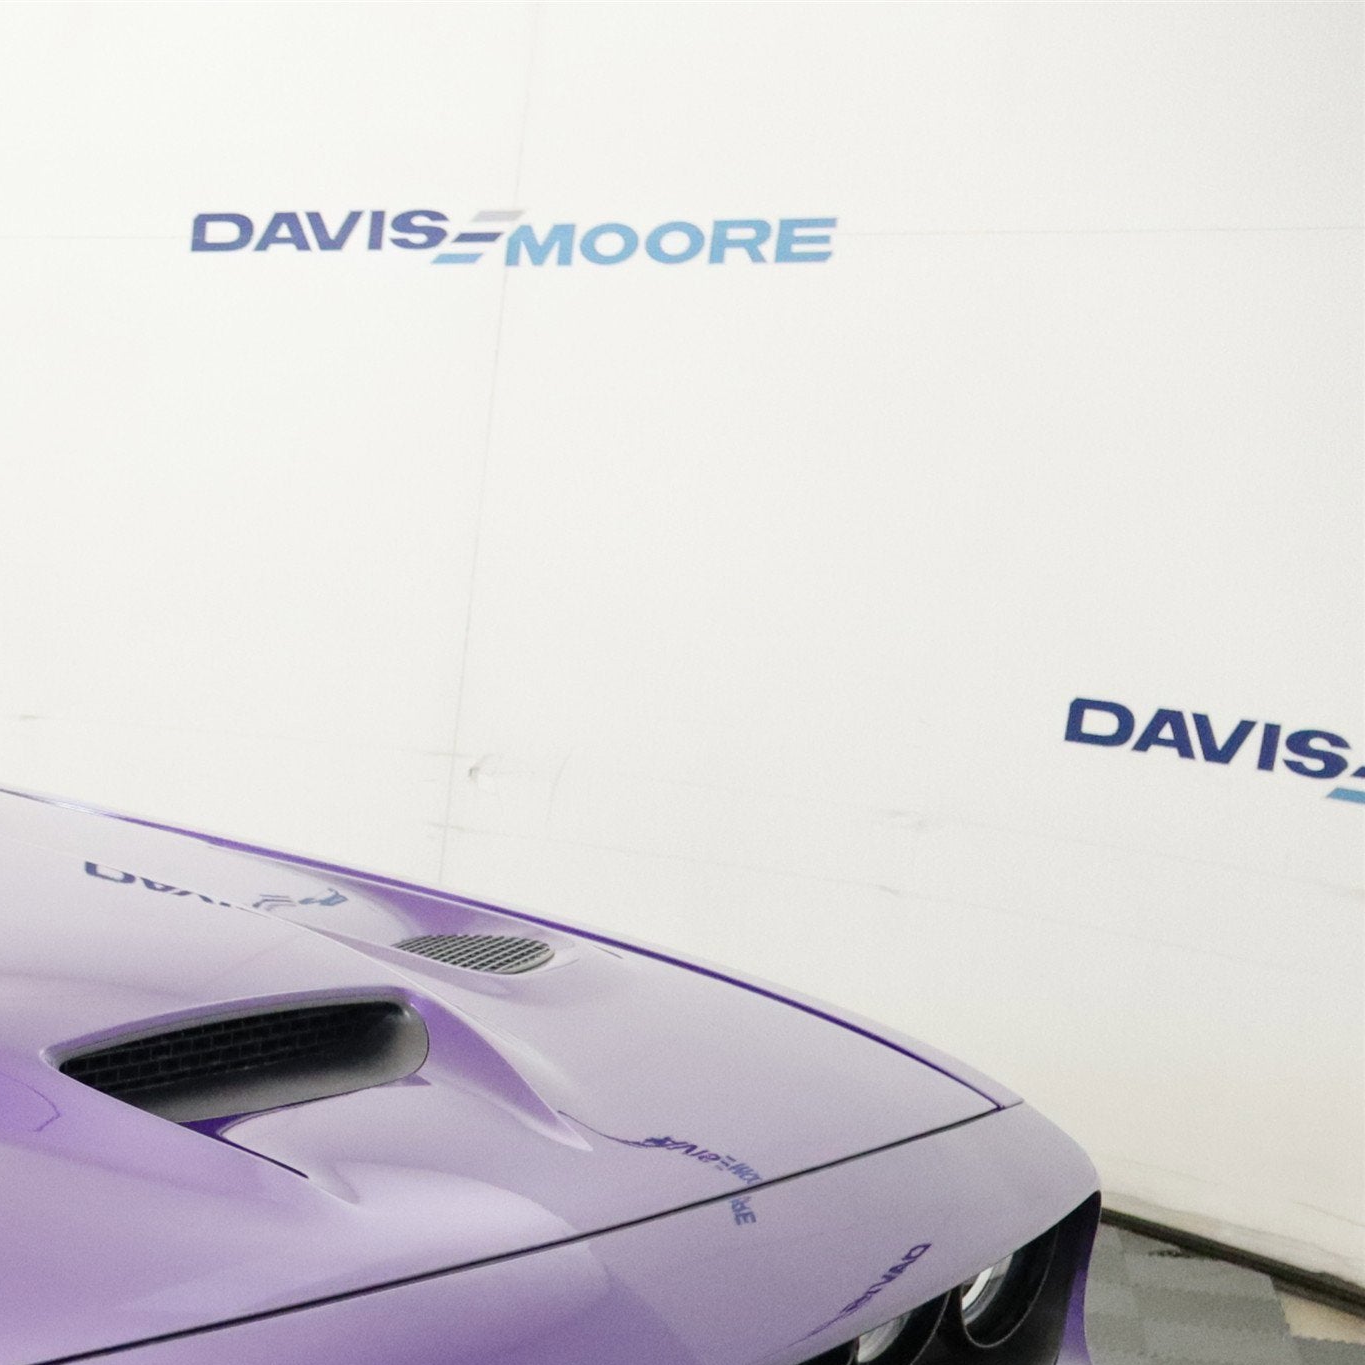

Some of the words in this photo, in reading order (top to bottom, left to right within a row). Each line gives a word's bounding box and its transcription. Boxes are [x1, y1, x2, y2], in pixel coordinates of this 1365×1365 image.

[189, 209, 449, 253] DAVIS
[504, 216, 839, 267] MOORE
[1064, 696, 1352, 780] DAVIS
